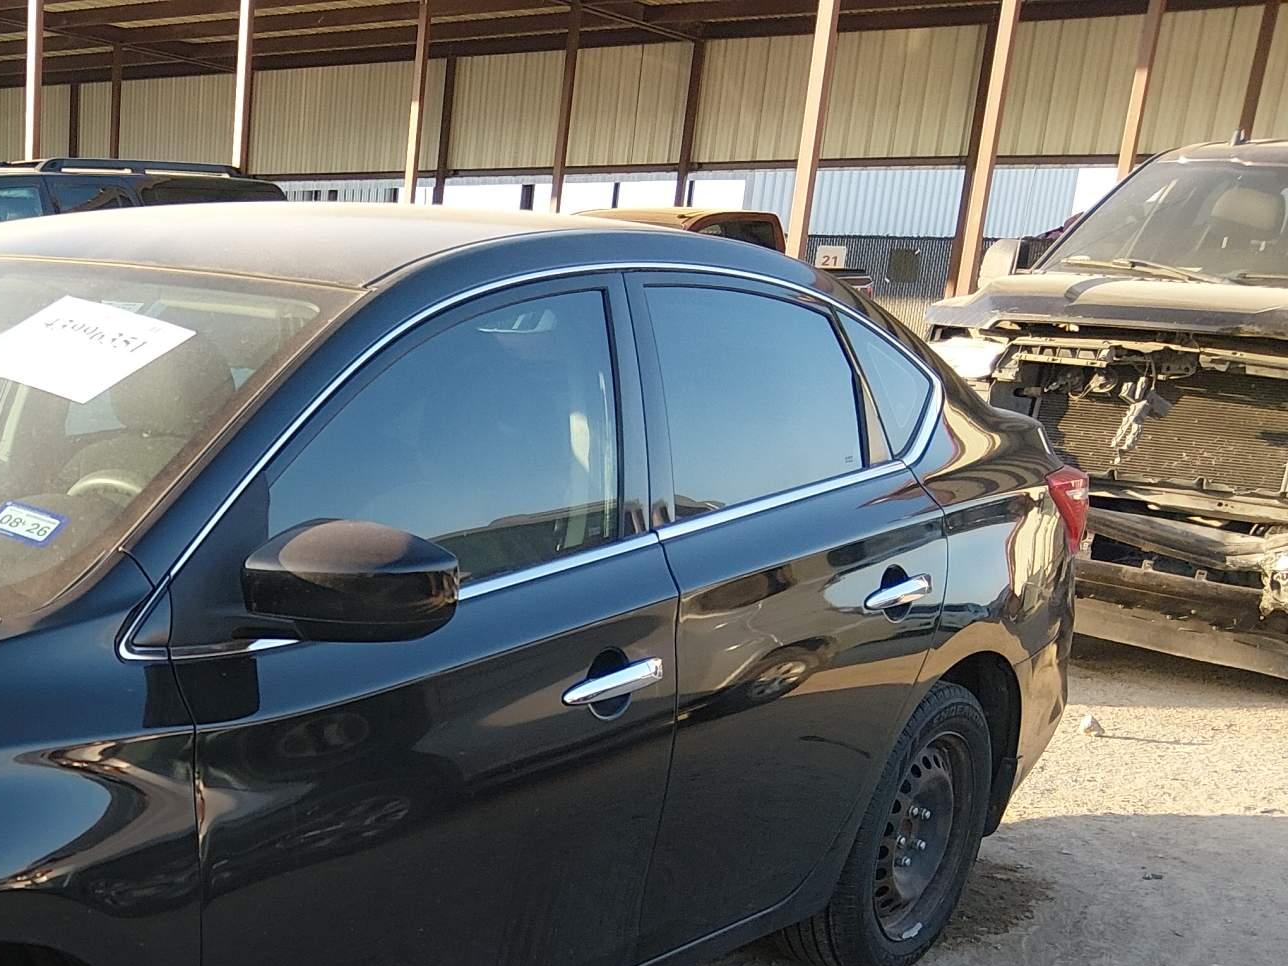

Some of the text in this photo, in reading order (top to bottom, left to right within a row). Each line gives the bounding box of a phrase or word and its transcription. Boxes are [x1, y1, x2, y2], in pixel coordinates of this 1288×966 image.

[821, 255, 838, 267] 21
[0, 514, 23, 528] 08
[25, 522, 51, 537] 26
